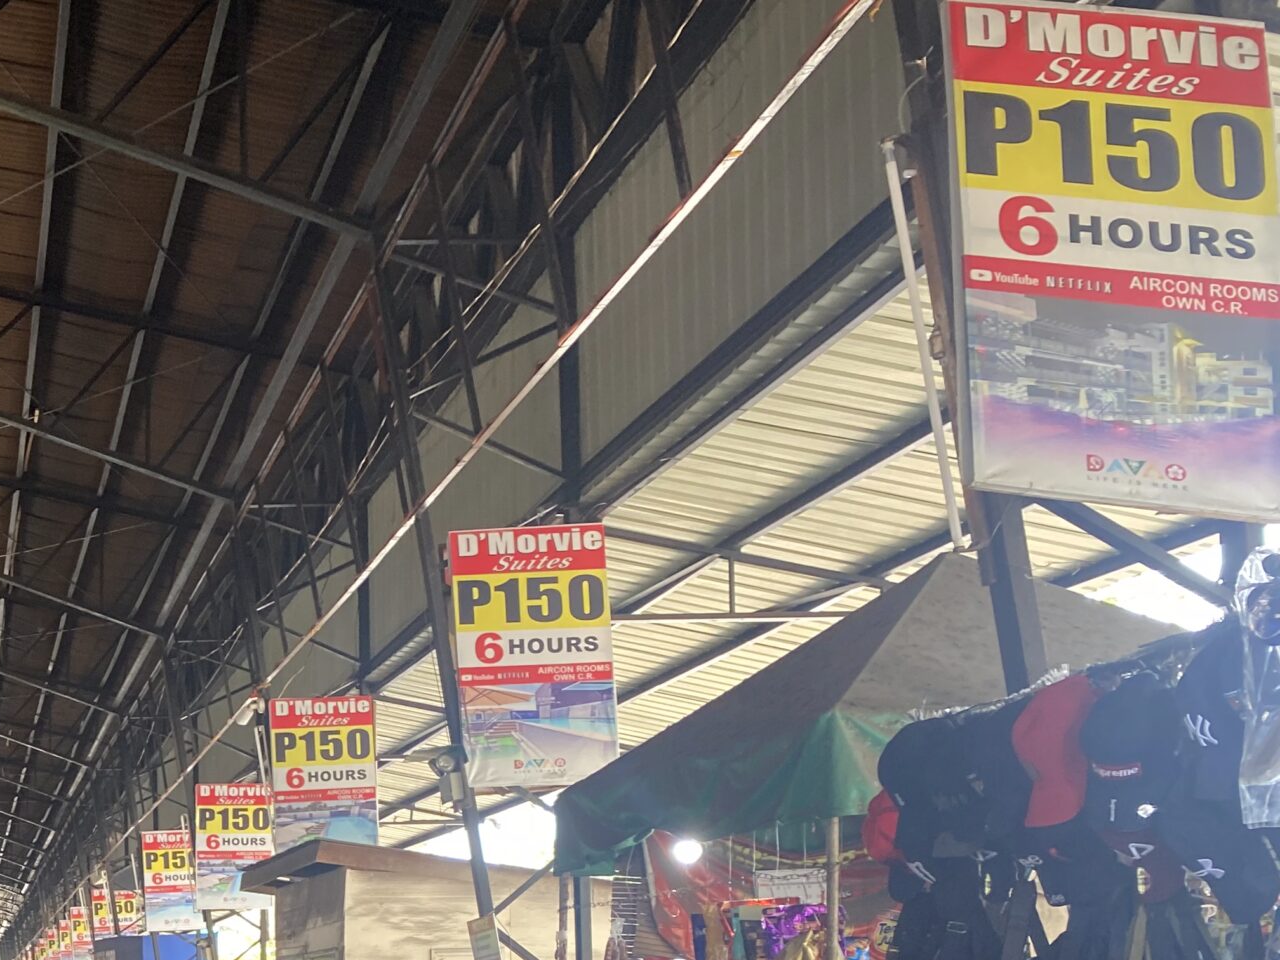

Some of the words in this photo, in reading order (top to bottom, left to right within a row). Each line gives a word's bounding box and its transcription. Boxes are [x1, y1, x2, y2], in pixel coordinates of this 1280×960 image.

[964, 6, 1261, 71] D'Morvie
[1035, 56, 1201, 96] Suites
[963, 90, 1266, 201] P150
[998, 195, 1059, 256] 6
[1068, 213, 1256, 260] HOURS
[994, 271, 1040, 287] YouTube
[1045, 275, 1113, 294] NETFLIX
[1129, 275, 1204, 296] AIRCON
[1209, 284, 1279, 303] ROOMS
[1161, 295, 1207, 312] OWN
[1211, 300, 1249, 315] C.R.
[457, 529, 603, 557] D'Morvie
[492, 555, 574, 572] Suites
[456, 573, 605, 625] P150
[475, 632, 504, 664] 6
[508, 636, 600, 655] HOURS
[538, 666, 574, 675] AIRCON
[576, 664, 611, 673] ROOMS
[553, 673, 576, 682] OWN
[275, 699, 370, 717] D'Morvie
[297, 715, 350, 727] Suites
[274, 728, 371, 763] P150
[285, 767, 306, 789] 6
[308, 769, 368, 783] HOURS
[216, 796, 256, 805] Suites
[198, 807, 271, 831] P150
[206, 834, 220, 850] 6
[222, 837, 267, 846] HOURS
[152, 872, 163, 885] 6
[99, 916, 107, 927] 6
